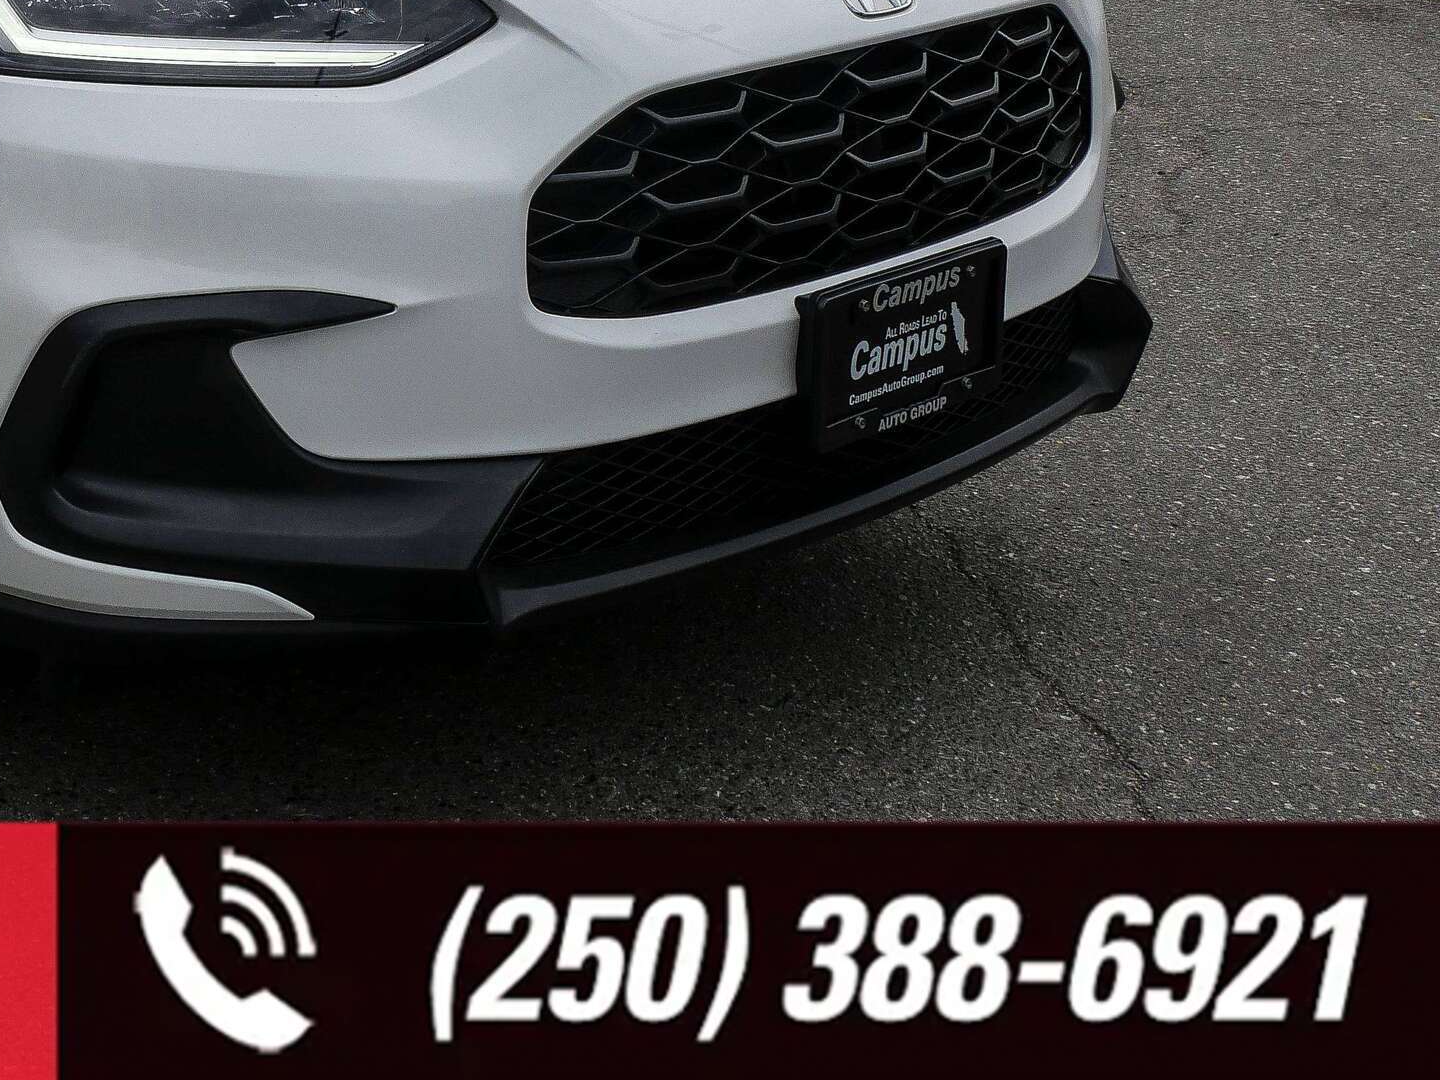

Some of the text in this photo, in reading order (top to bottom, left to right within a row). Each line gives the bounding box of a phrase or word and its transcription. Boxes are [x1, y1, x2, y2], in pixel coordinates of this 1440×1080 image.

[872, 266, 961, 313] Campus
[850, 323, 948, 382] Campus
[849, 365, 945, 407] CampusAutoGroup.com
[877, 396, 948, 433] AUTO GROUP
